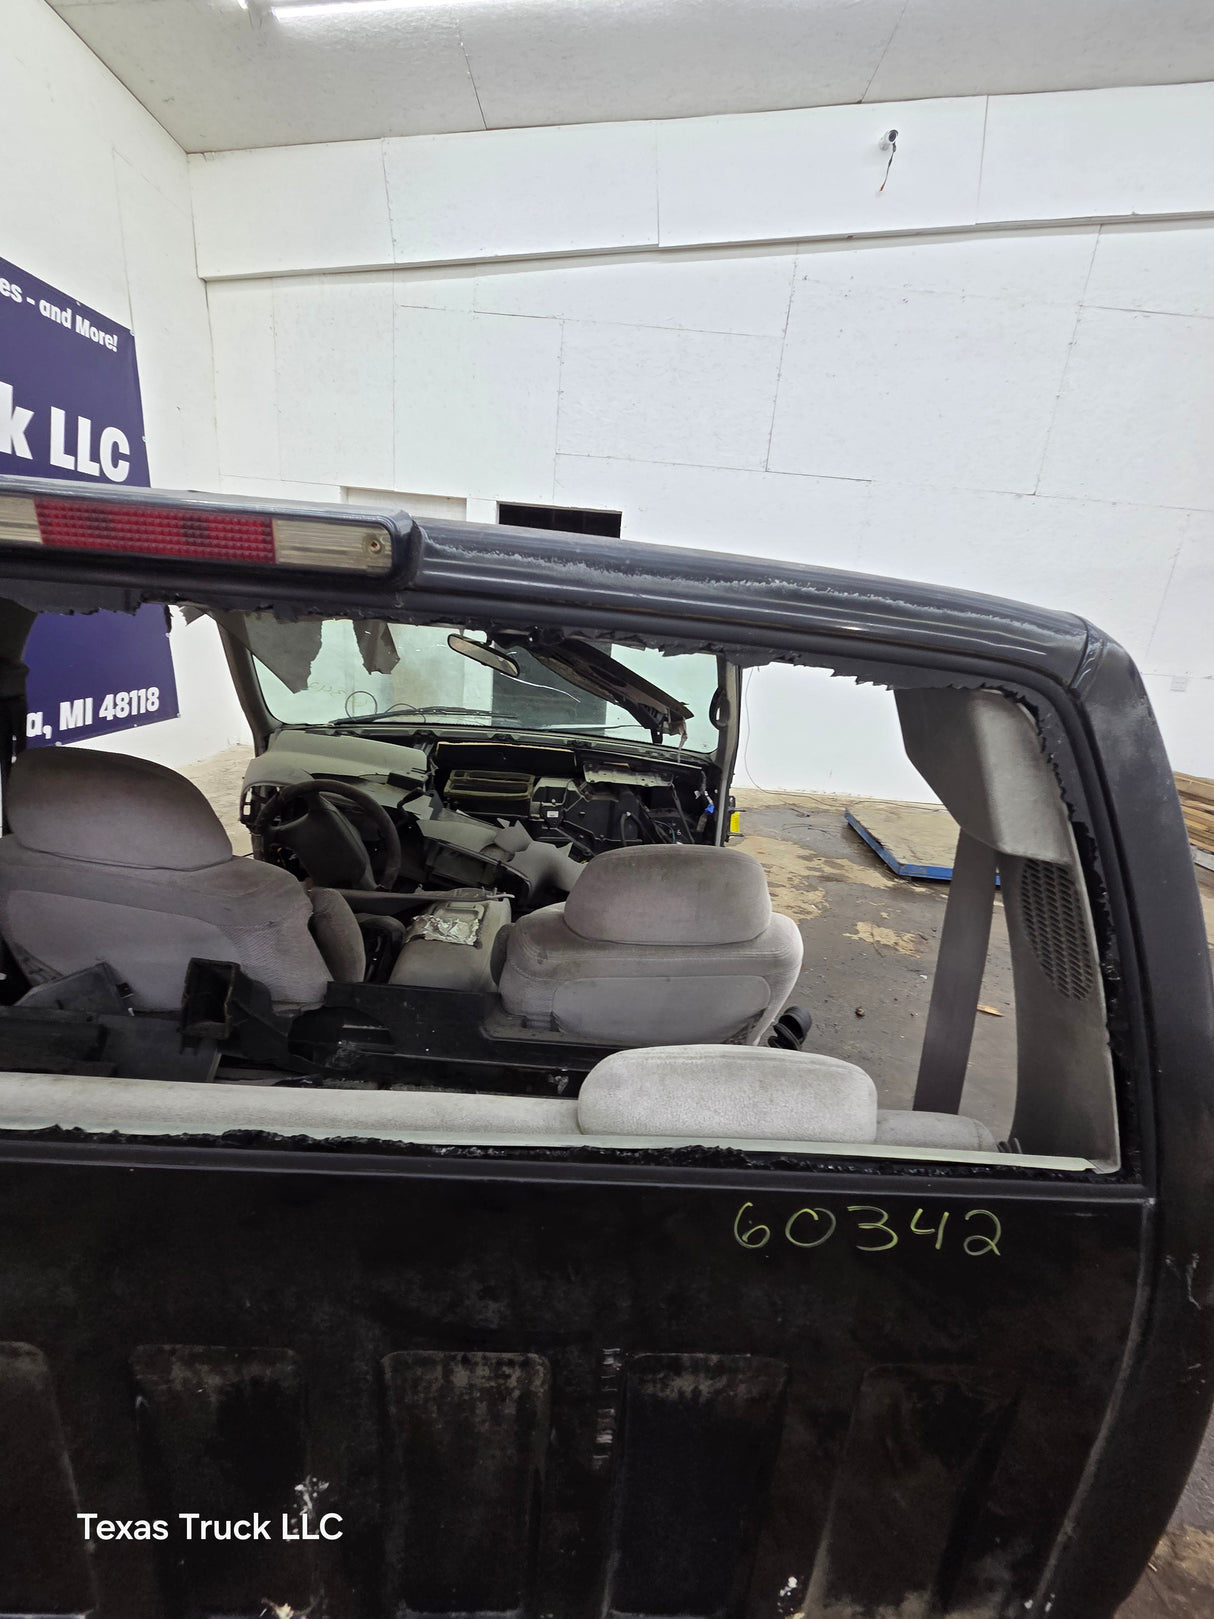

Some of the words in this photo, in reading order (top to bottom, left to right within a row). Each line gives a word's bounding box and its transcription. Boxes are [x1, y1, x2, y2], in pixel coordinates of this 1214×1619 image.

[39, 299, 73, 330] and
[75, 314, 118, 352] More!
[50, 406, 130, 483] LLC
[59, 698, 93, 731] MI
[99, 687, 160, 721] 48118
[734, 1202, 1001, 1256] 60342
